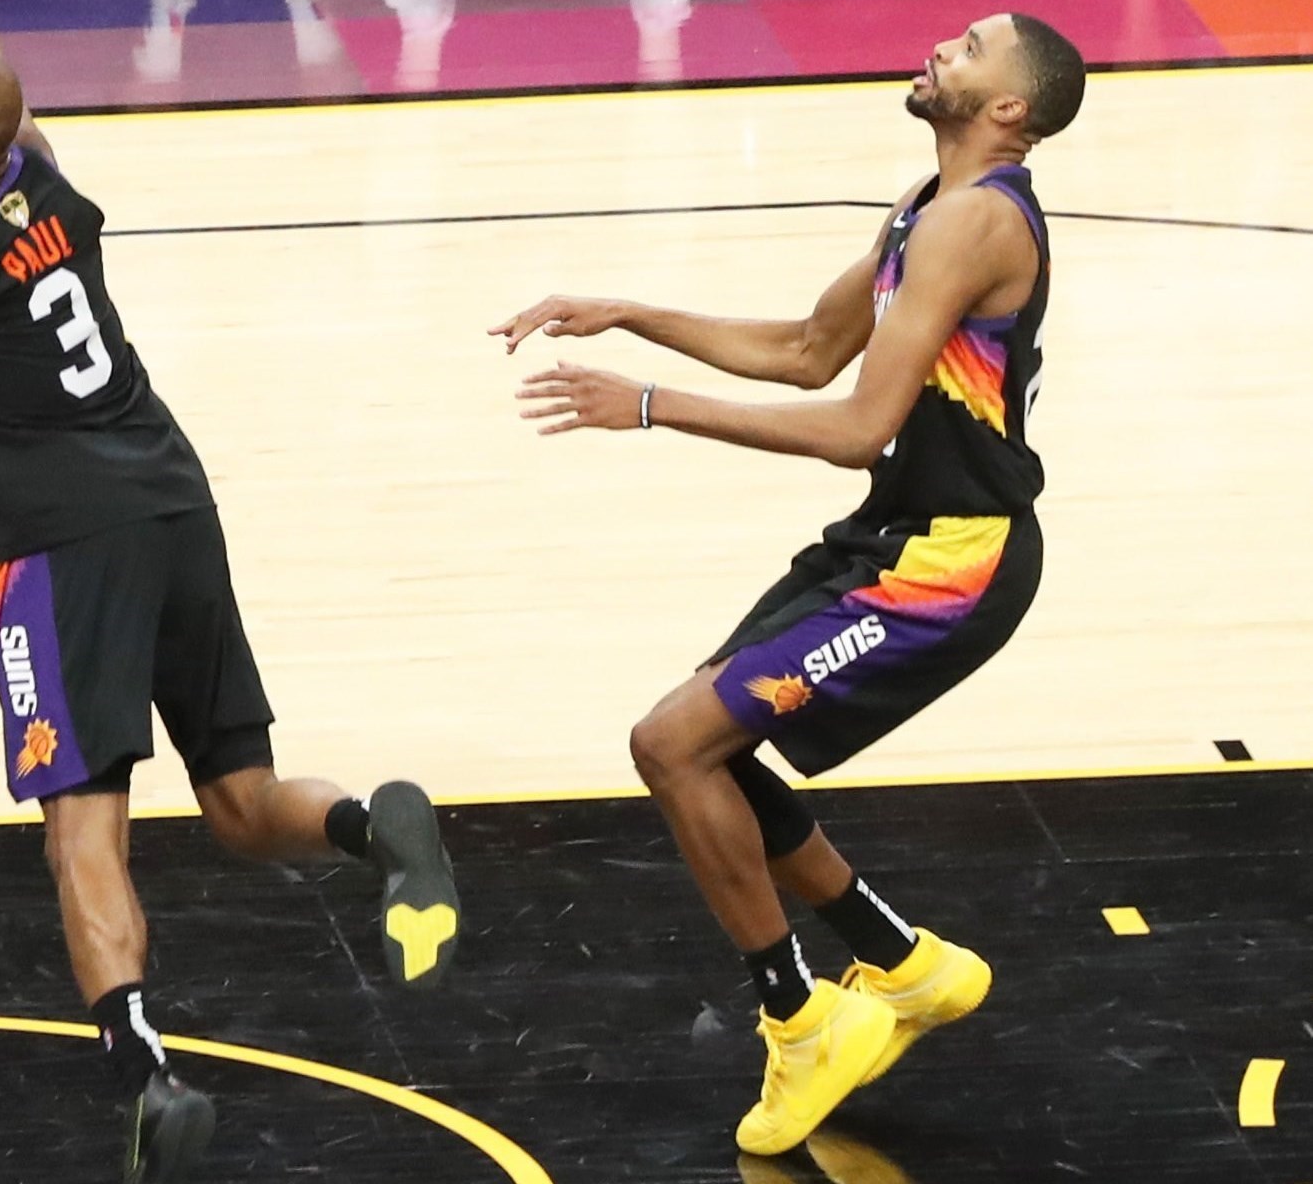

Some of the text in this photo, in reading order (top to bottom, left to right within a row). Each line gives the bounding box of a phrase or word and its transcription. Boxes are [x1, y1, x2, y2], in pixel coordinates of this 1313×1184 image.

[0, 215, 75, 284] PAUL
[27, 266, 113, 399] 3
[0, 624, 38, 718] SUNS
[803, 614, 887, 685] SUNS
